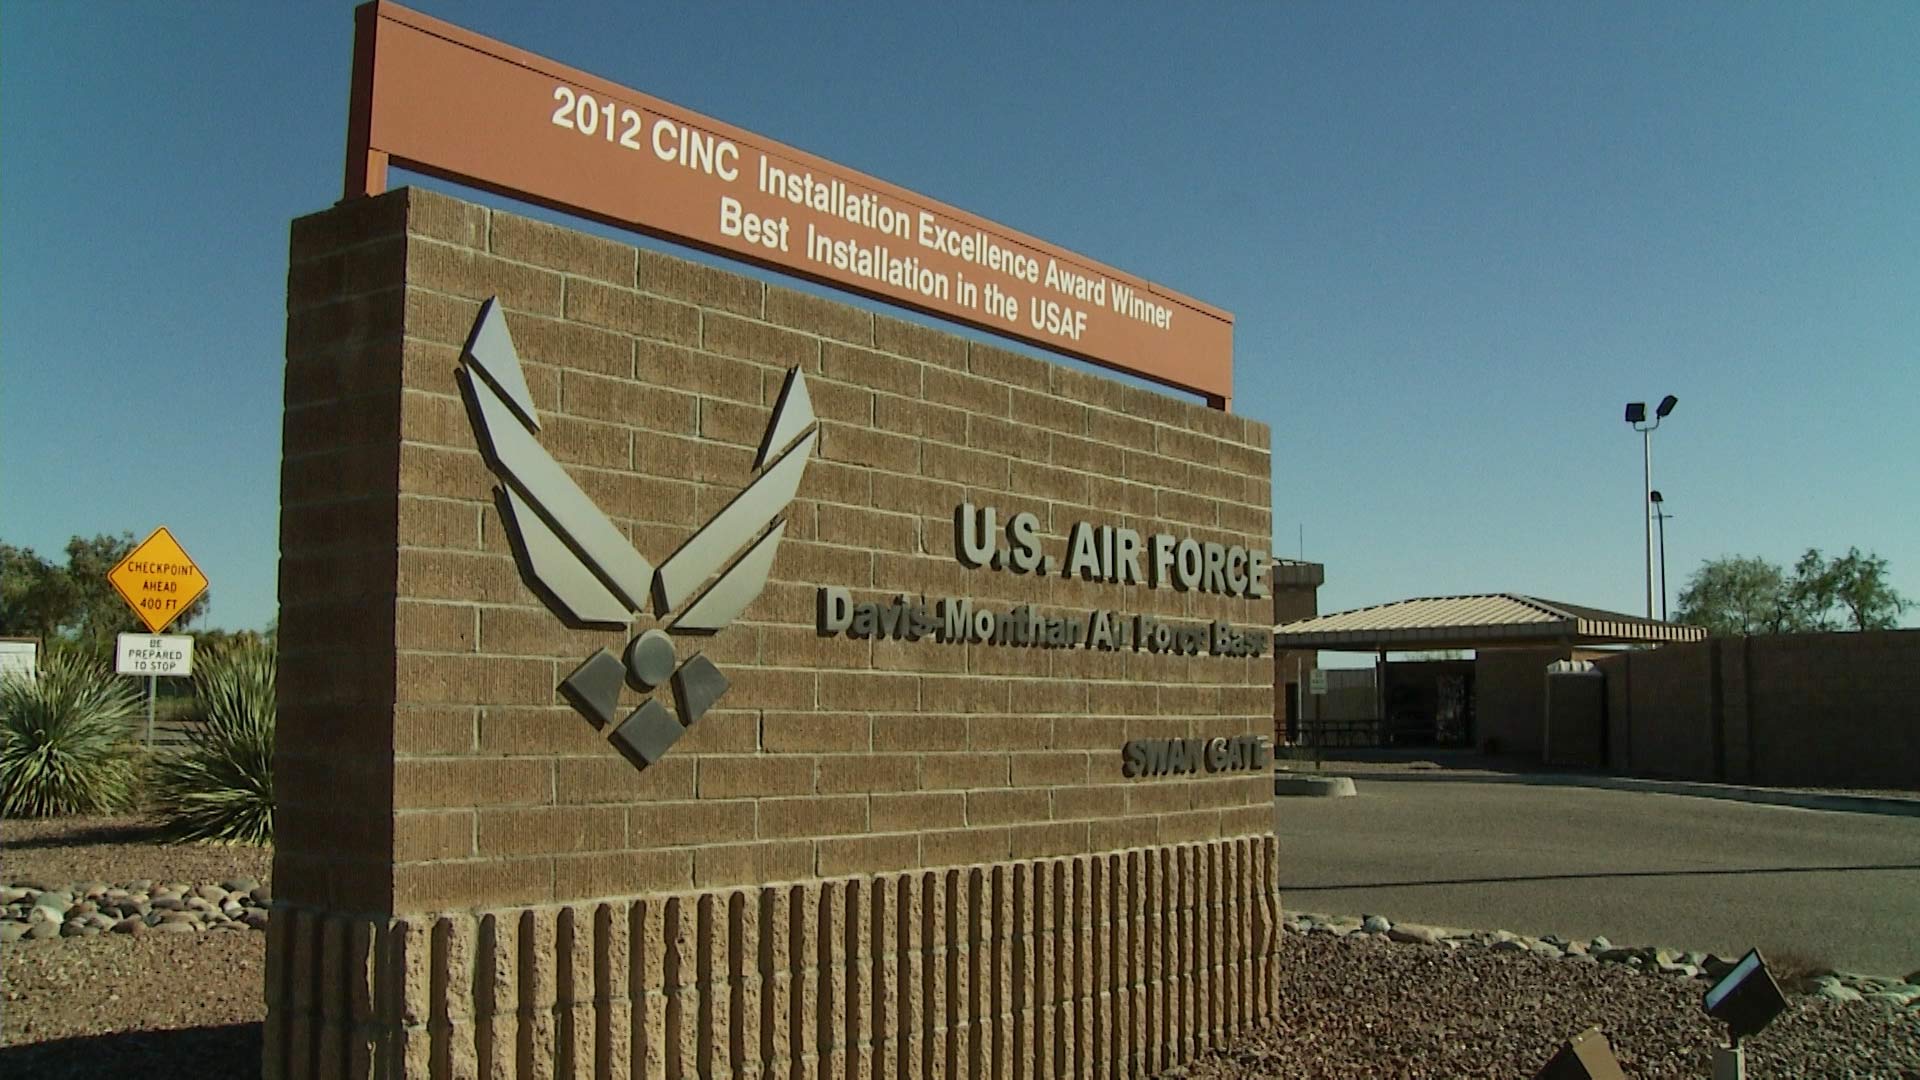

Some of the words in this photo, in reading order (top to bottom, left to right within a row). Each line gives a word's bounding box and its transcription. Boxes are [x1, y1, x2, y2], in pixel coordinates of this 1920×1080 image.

[552, 86, 642, 150] 2012
[652, 119, 740, 182] CINC
[759, 154, 911, 240] Installation
[918, 211, 1039, 283] Excellence
[1044, 258, 1106, 306] Award
[1111, 282, 1173, 330] Winner
[720, 196, 789, 252] Best
[807, 223, 949, 300] Installation
[956, 272, 977, 310] in
[984, 282, 1018, 322] the
[1031, 296, 1087, 340] USAF
[957, 502, 1055, 574] U.S.
[1066, 521, 1140, 585] AIR
[1150, 533, 1270, 599] FORCE
[128, 561, 193, 575] CHECKPOINT
[142, 581, 177, 593] AHEAD
[140, 598, 161, 609] 400
[166, 600, 177, 609] FT
[1136, 613, 1209, 656] Force
[1212, 620, 1268, 658] Base
[149, 639, 162, 648] BE
[128, 649, 182, 660] PREPARED
[135, 661, 147, 670] TO
[150, 661, 176, 672] STOP
[1124, 739, 1202, 777] SWAN
[1206, 736, 1274, 773] GATE
